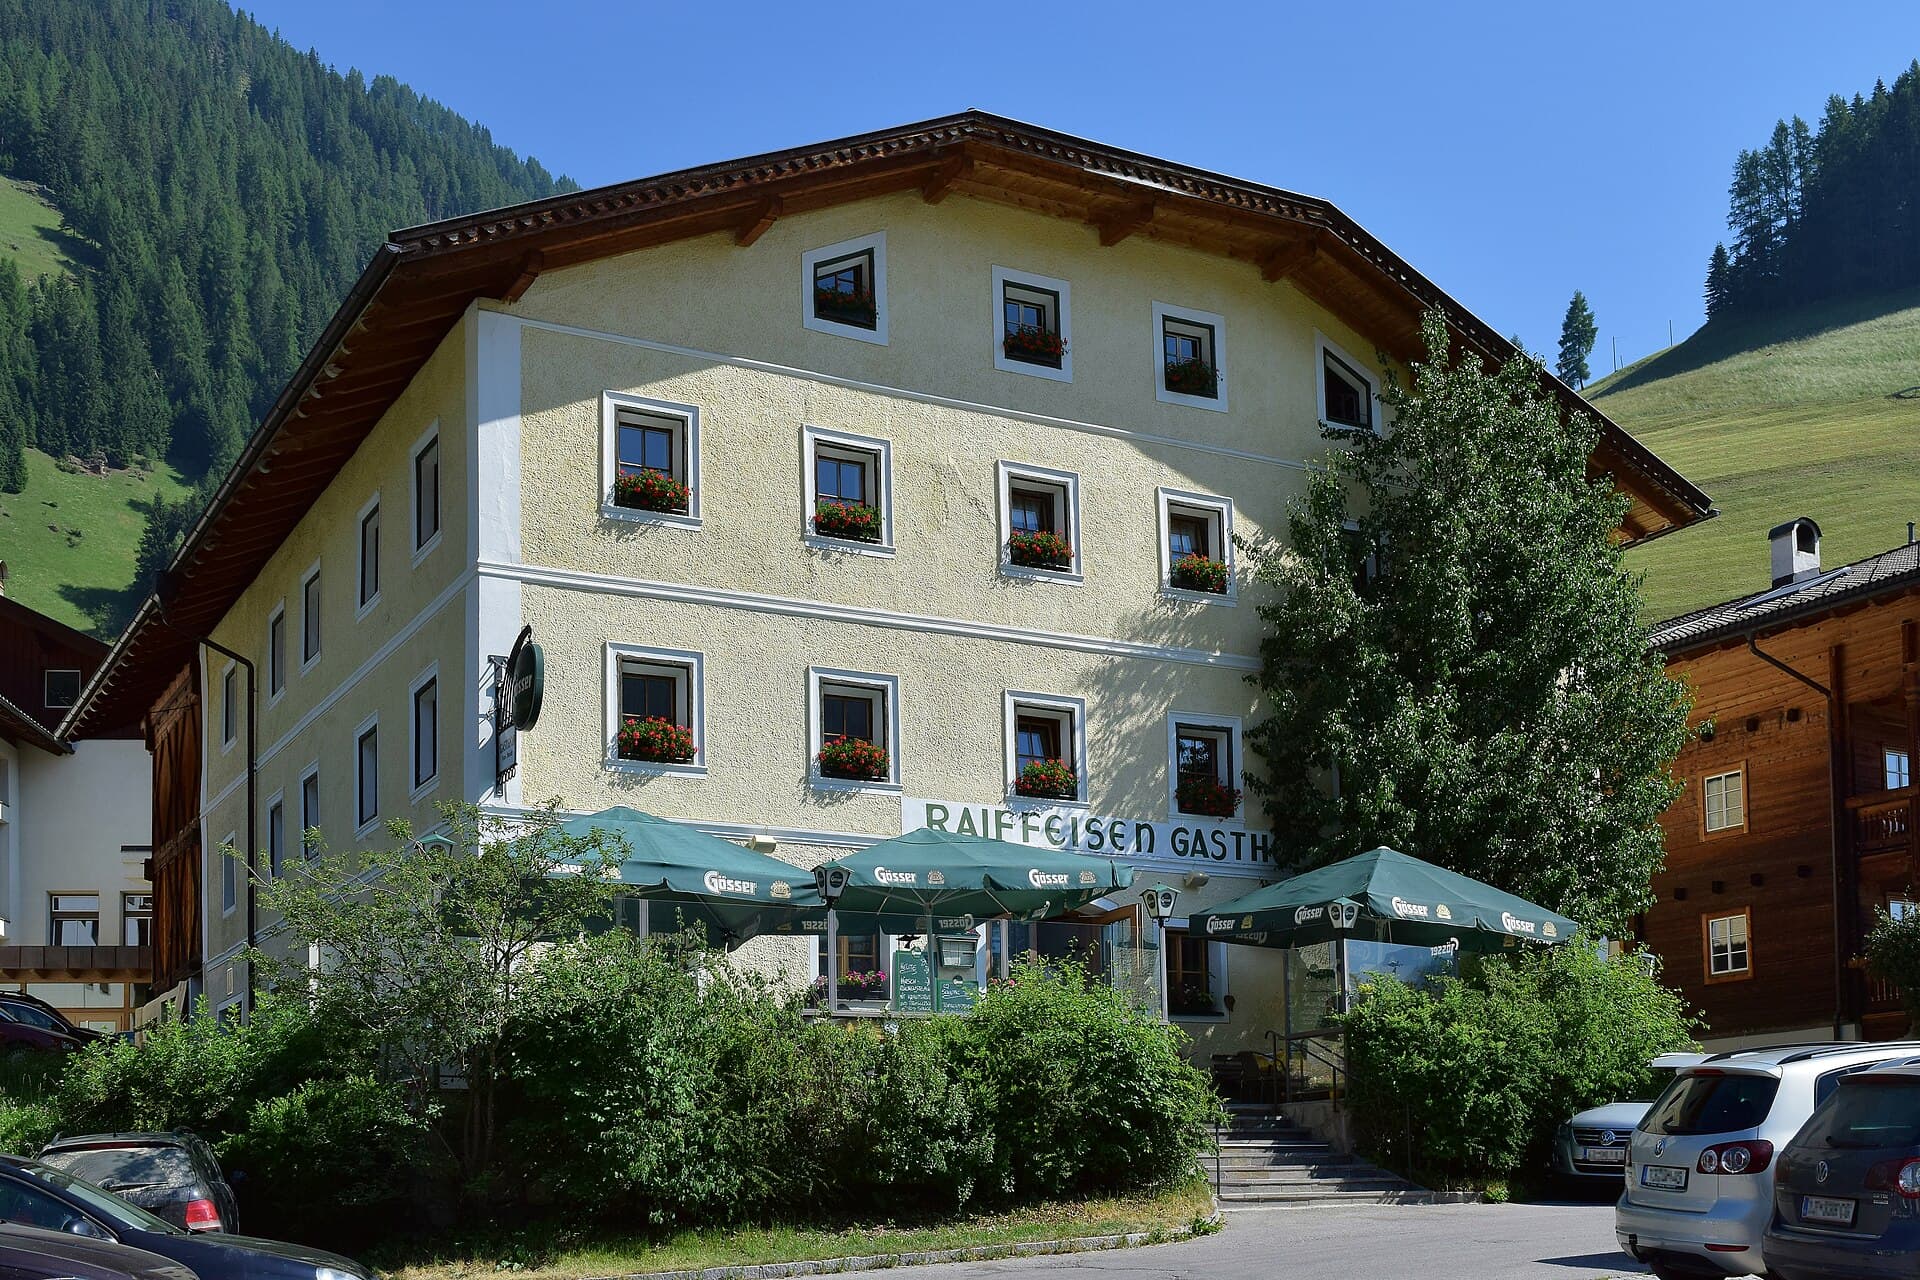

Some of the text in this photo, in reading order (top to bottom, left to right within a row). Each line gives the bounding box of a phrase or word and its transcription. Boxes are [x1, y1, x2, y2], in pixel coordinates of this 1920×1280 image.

[1170, 827, 1269, 863] GASTH
[703, 870, 757, 895] Gösser
[874, 866, 917, 884] Gösser
[1028, 868, 1069, 888] Gösser
[1294, 905, 1324, 925] Gösser
[1390, 896, 1428, 917] Gösser
[1206, 915, 1235, 934] Gösser
[1501, 911, 1536, 933] Gösser
